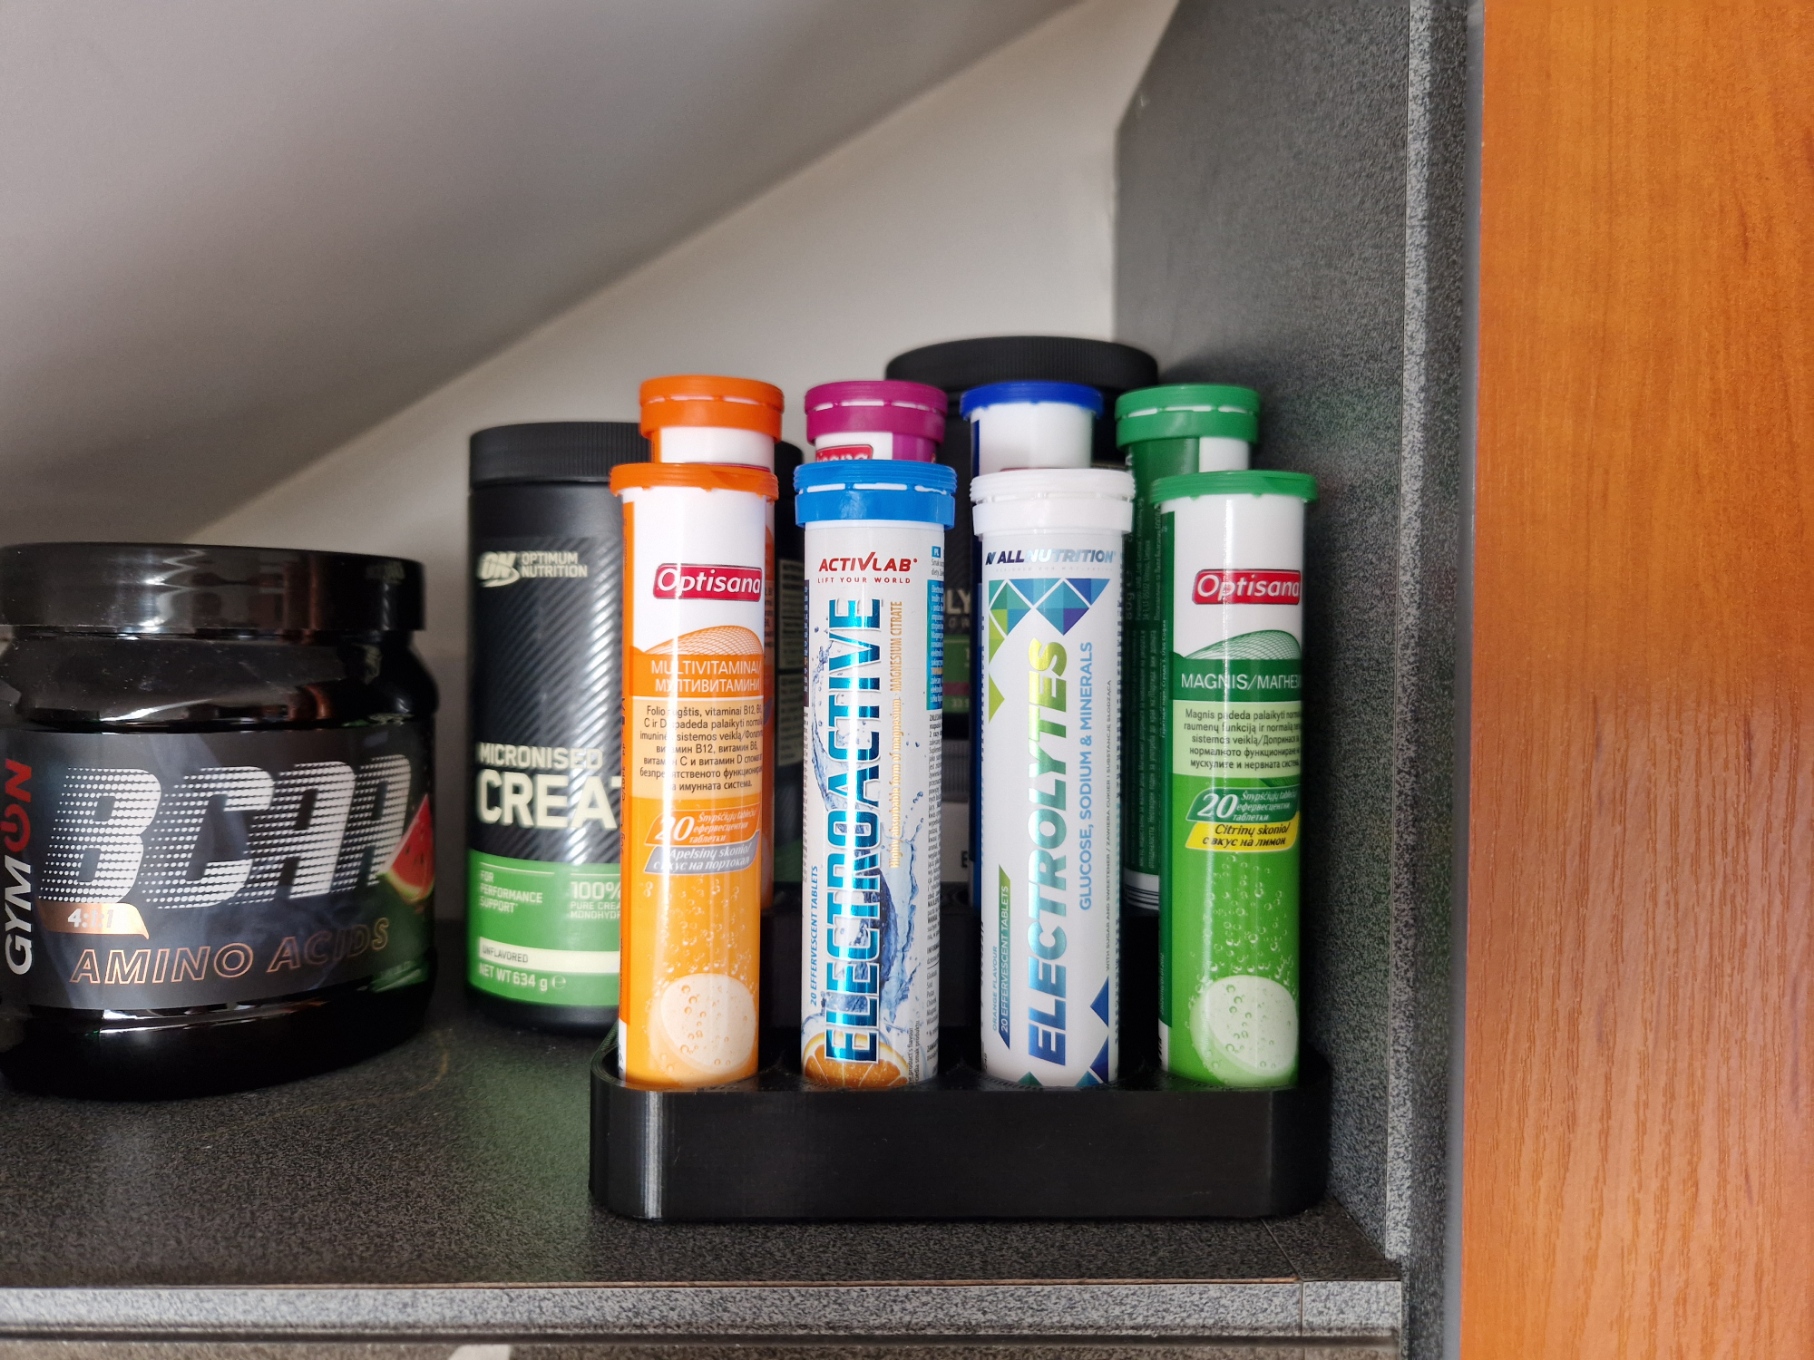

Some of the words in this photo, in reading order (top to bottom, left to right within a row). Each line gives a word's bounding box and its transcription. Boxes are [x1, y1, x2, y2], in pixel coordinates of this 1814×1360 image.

[521, 551, 579, 565] OPTIMUM
[819, 552, 913, 572] ACTIVLAB
[997, 549, 1114, 564] ALLNUTRITION
[520, 564, 588, 578] NUTRITION
[657, 568, 761, 598] Optisana
[1197, 574, 1300, 601] Optisana
[890, 601, 902, 636] CITRATE
[890, 638, 902, 692] MAGNESIUM
[1080, 642, 1092, 730] MINERALS
[647, 705, 666, 716] Folio
[705, 706, 741, 716] vitaminai
[1185, 708, 1215, 721] Magnis
[1253, 710, 1285, 721] palaikyti
[644, 718, 650, 728] C
[652, 718, 658, 727] ir
[660, 718, 667, 728] D
[711, 719, 744, 731] palaikyti
[890, 699, 903, 751] magnesium
[1184, 722, 1219, 734] raumenų
[1259, 723, 1264, 732] ir
[676, 732, 717, 741] sistemos
[1080, 735, 1092, 746] &
[478, 741, 603, 770] MICRONISED
[719, 744, 749, 754] витамин
[889, 752, 901, 763] of
[691, 758, 696, 766] и
[699, 757, 735, 766] витамин
[737, 755, 743, 764] D
[1244, 761, 1280, 770] нервната
[889, 764, 901, 786] form
[1079, 751, 1092, 820] SODIUM
[680, 781, 721, 793] имунната
[888, 788, 901, 837] absorbable
[1197, 793, 1238, 818] 20
[1233, 813, 1269, 821] таблетки
[39, 754, 412, 909] BCAA
[655, 815, 695, 841] 20
[826, 599, 881, 1062] ELECTROACTIVE
[1215, 824, 1255, 837] Citrinų
[1028, 637, 1067, 1066] ELECTROLYTES
[1202, 837, 1209, 845] с
[1211, 838, 1238, 848] вкус
[1240, 838, 1253, 847] на
[1256, 838, 1286, 847] лимон
[888, 839, 903, 868] Highly
[480, 869, 494, 883] FOR
[689, 861, 702, 870] на
[1079, 824, 1093, 910] GLUCOSE,
[480, 882, 543, 904] PERFORMANCE
[810, 866, 818, 910] TABLETS
[570, 901, 595, 911] PURE
[1001, 886, 1009, 931] TABLETS
[70, 942, 255, 985] AMINO
[267, 916, 390, 974] ACIDS
[482, 944, 528, 963] UNFLAVORED
[810, 913, 818, 991] EFFERVESCENT
[480, 962, 495, 978] NET
[496, 968, 513, 983] WT
[513, 971, 536, 987] 634
[1001, 935, 1009, 1017] EFFERVESCENT
[810, 992, 818, 1006] 20
[1001, 1018, 1009, 1033] 20
